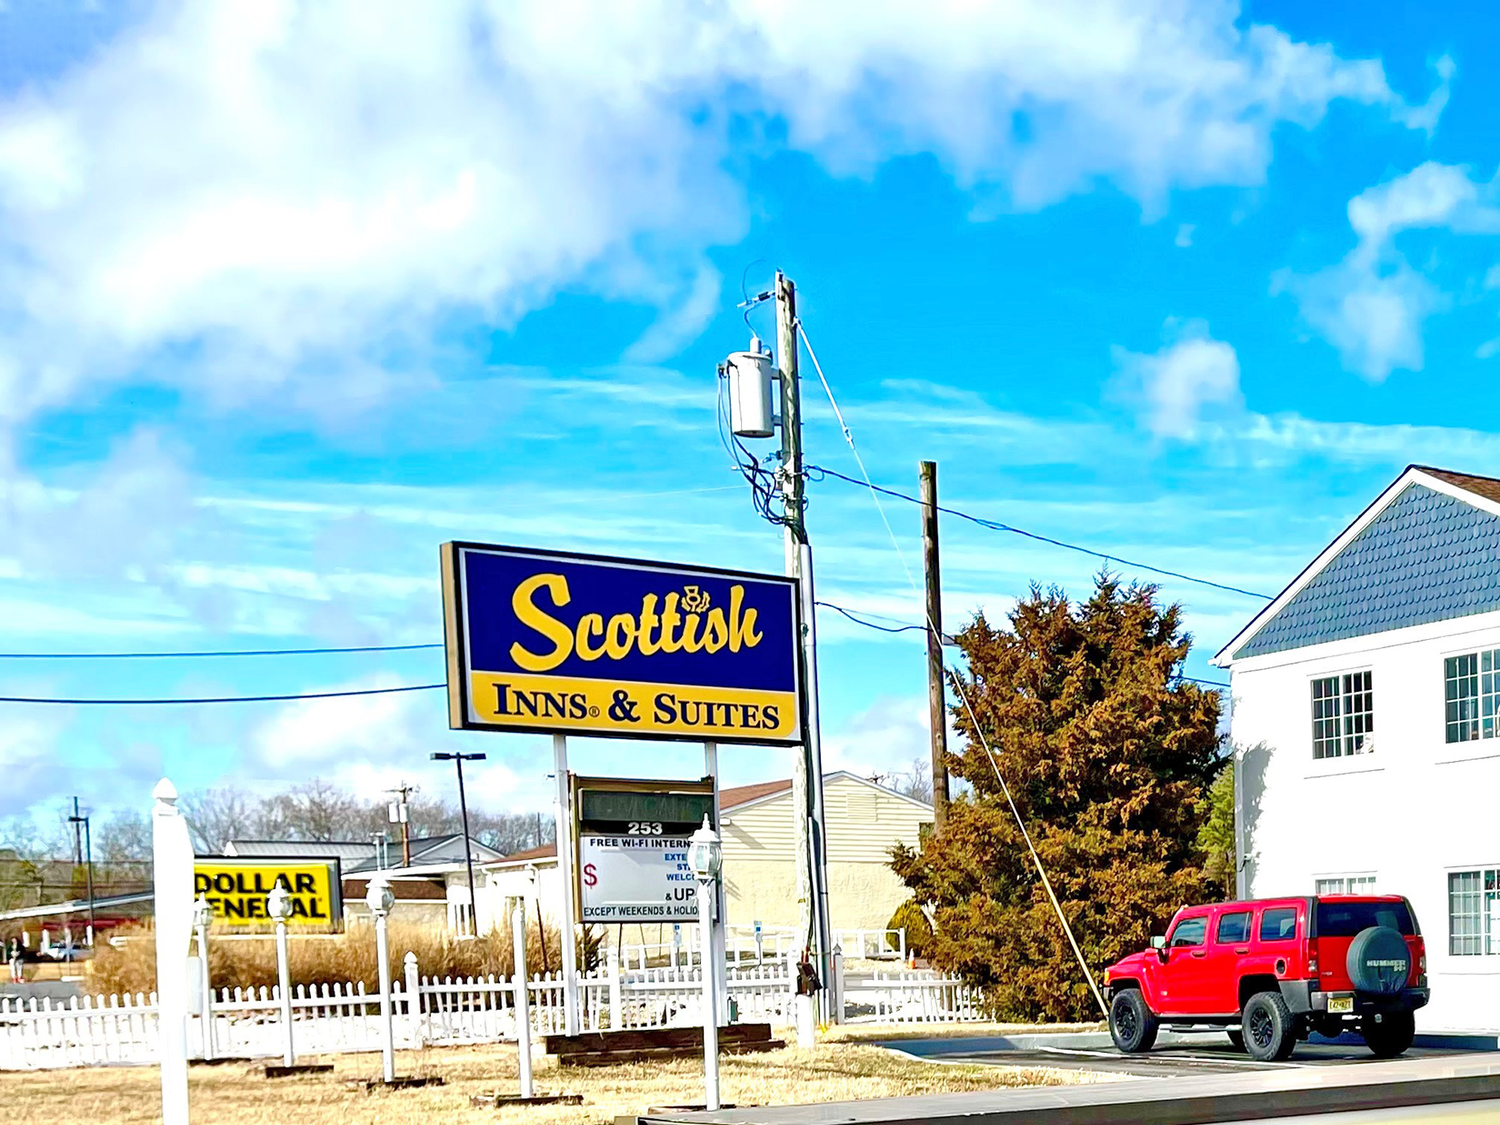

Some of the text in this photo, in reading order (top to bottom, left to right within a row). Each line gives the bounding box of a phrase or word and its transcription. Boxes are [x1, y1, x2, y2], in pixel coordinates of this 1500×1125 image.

[509, 573, 763, 672] Scottish
[608, 690, 641, 722] &
[653, 693, 780, 730] SUITES
[628, 822, 663, 835] 253
[590, 838, 694, 849] FREE WI-FI INTERN
[664, 853, 687, 861] EXTE
[676, 863, 691, 871] ST
[583, 863, 598, 890] $
[666, 873, 695, 881] WELC
[194, 873, 317, 894] DOLLAR
[665, 887, 695, 901] & UP
[194, 898, 327, 918] ENEAL
[583, 906, 699, 917] EXCEPT WEEKENDS & HOLID
